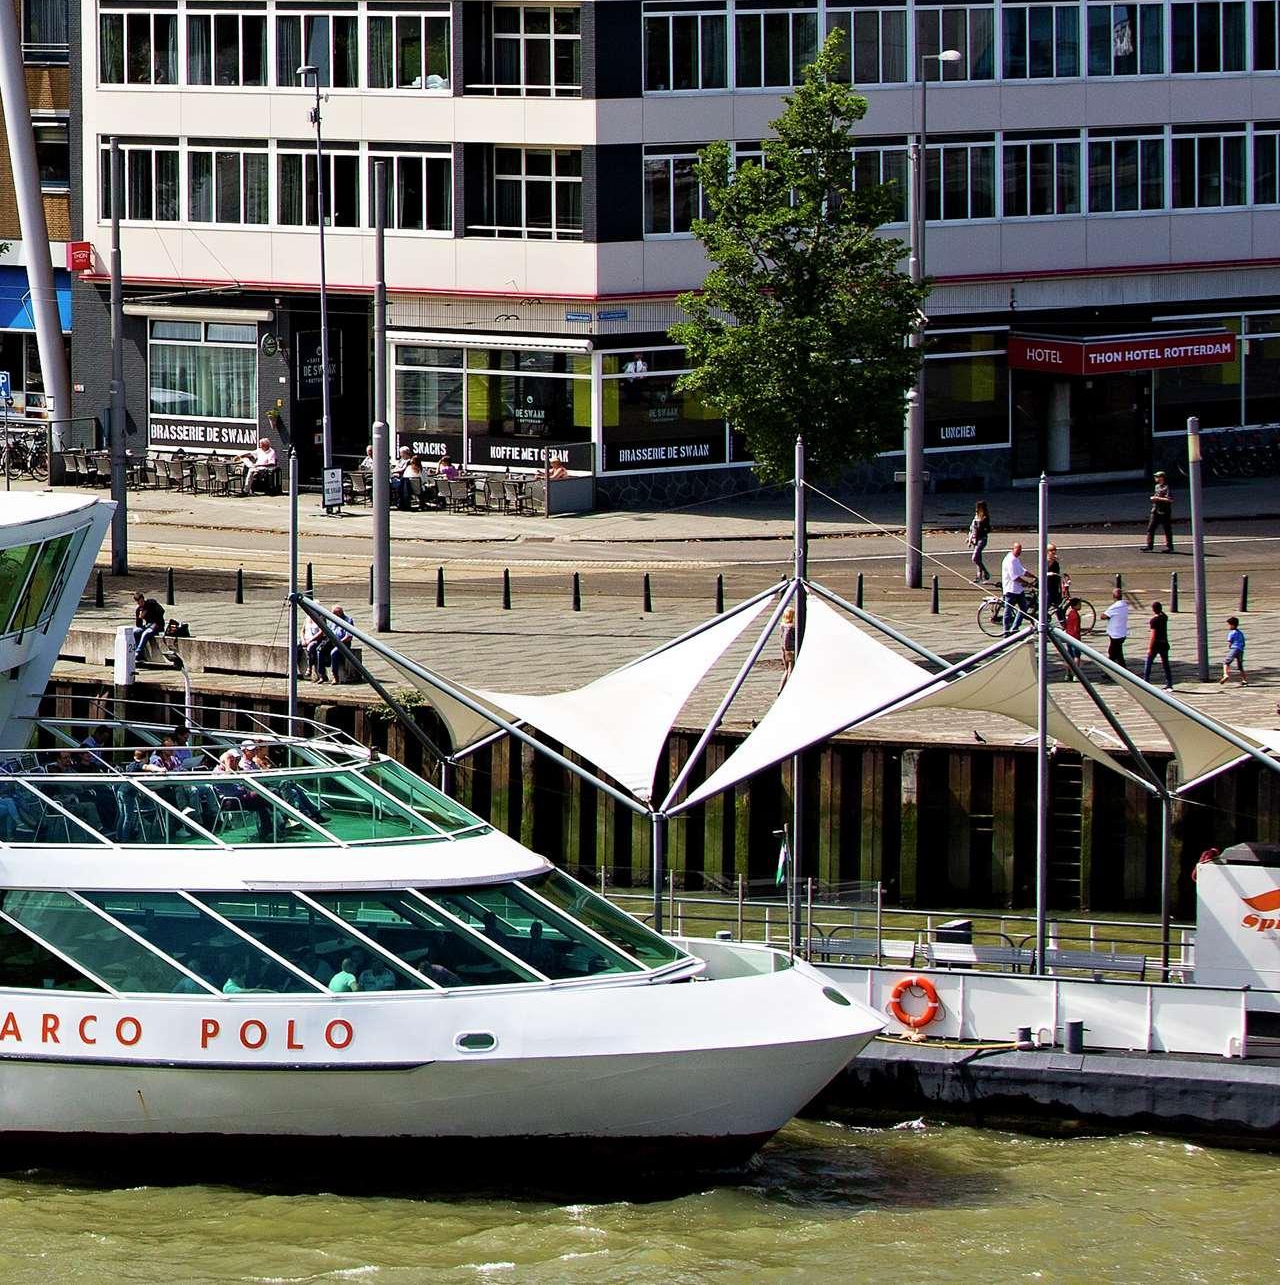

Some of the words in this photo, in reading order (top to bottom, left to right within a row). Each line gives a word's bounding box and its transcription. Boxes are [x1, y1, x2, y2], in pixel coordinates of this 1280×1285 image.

[1026, 348, 1062, 364] HOTEL
[1089, 352, 1122, 364] THON
[1125, 348, 1160, 361] HOTEL
[1164, 343, 1231, 359] ROTTERDAM
[151, 424, 205, 441] BRASSERIE
[206, 427, 219, 442] DE
[221, 428, 257, 444] SWAAN
[940, 425, 976, 439] LUNCHEN
[412, 441, 447, 456] SNACKS
[490, 446, 520, 459] KOFFIE
[521, 448, 539, 461] MET
[619, 446, 666, 463] BRASSERIE
[667, 446, 679, 459] DE
[680, 444, 709, 458] SWAAN
[201, 1018, 354, 1050] POLO
